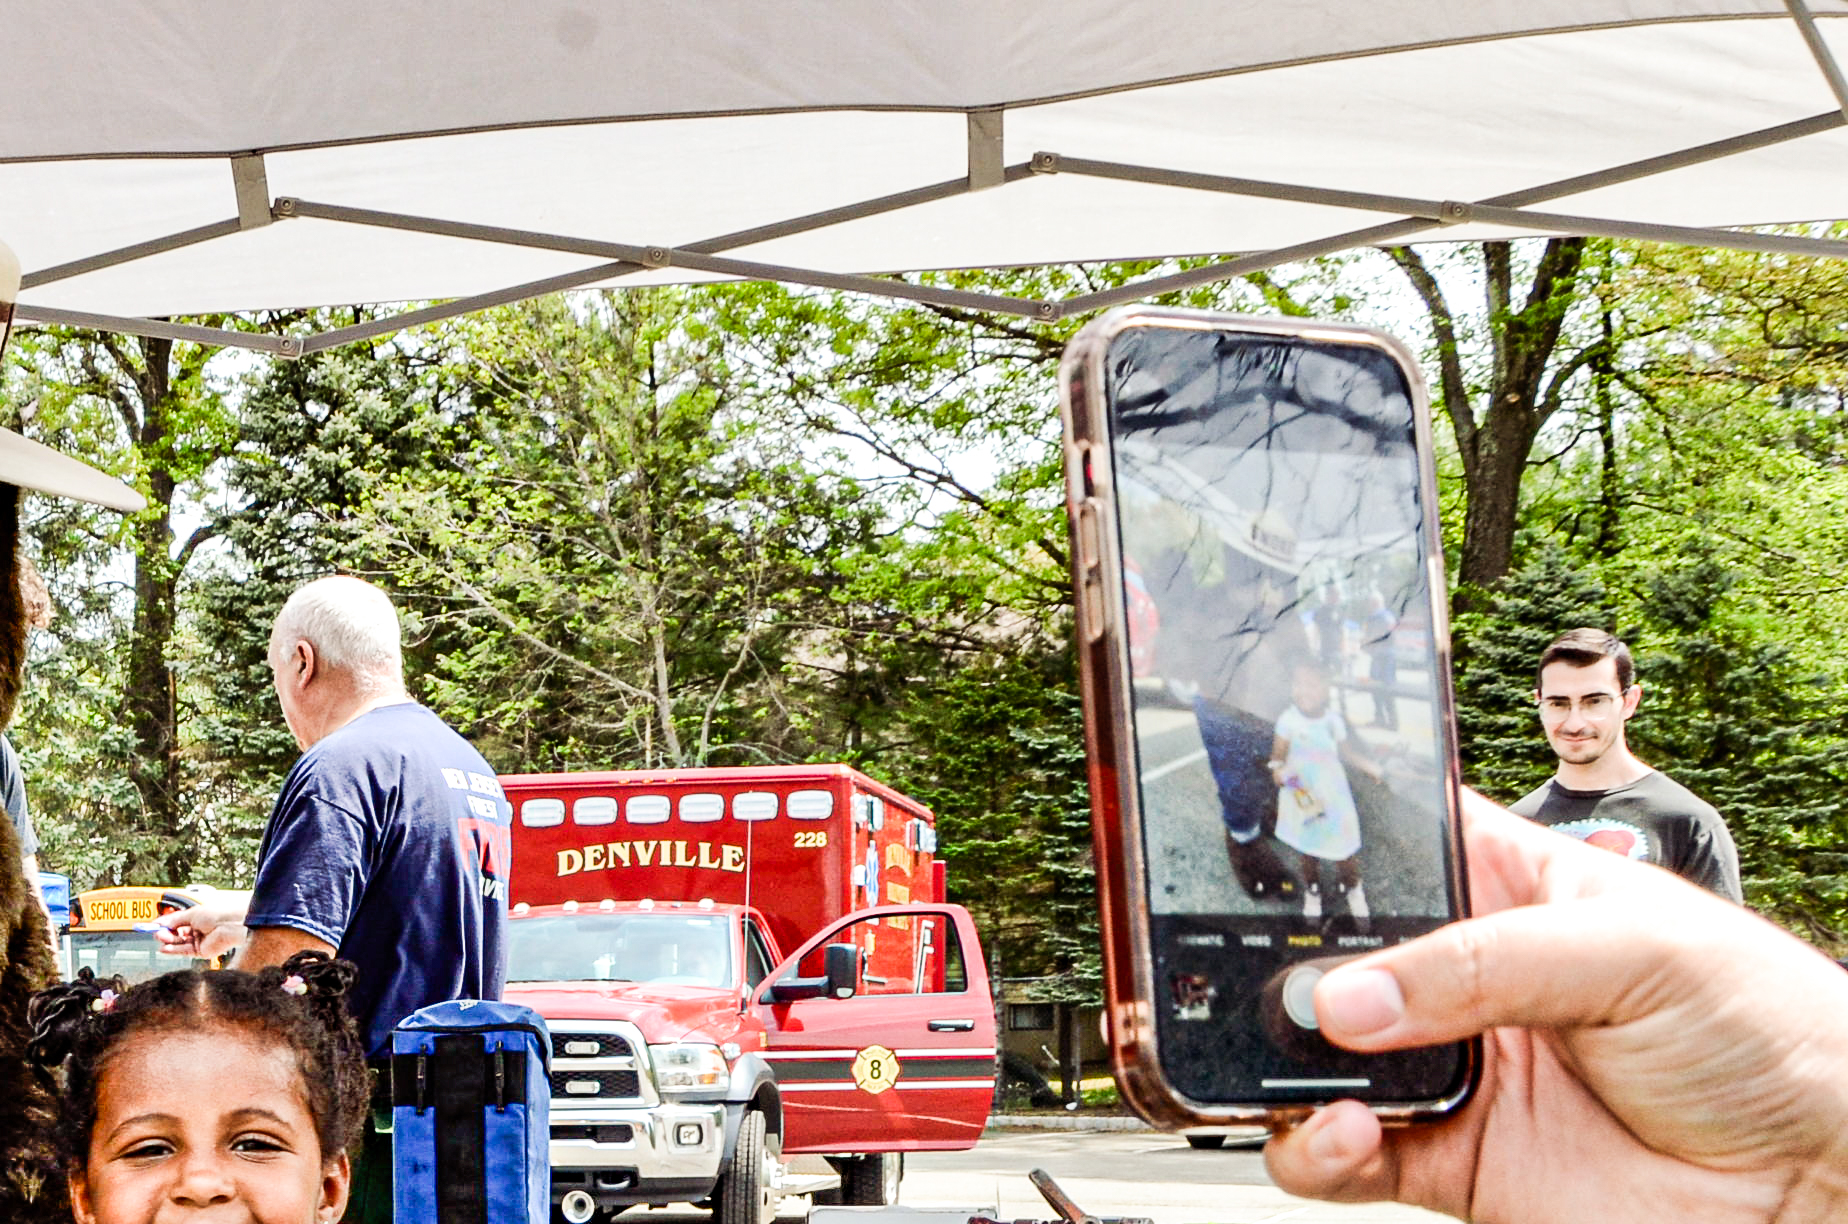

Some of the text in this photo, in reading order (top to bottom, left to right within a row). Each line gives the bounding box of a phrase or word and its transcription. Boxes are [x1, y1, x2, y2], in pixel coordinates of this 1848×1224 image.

[794, 831, 828, 848] 228
[556, 840, 746, 877] DENVILLE
[90, 900, 152, 921] SCHOOL BUS
[870, 1059, 882, 1080] 8
